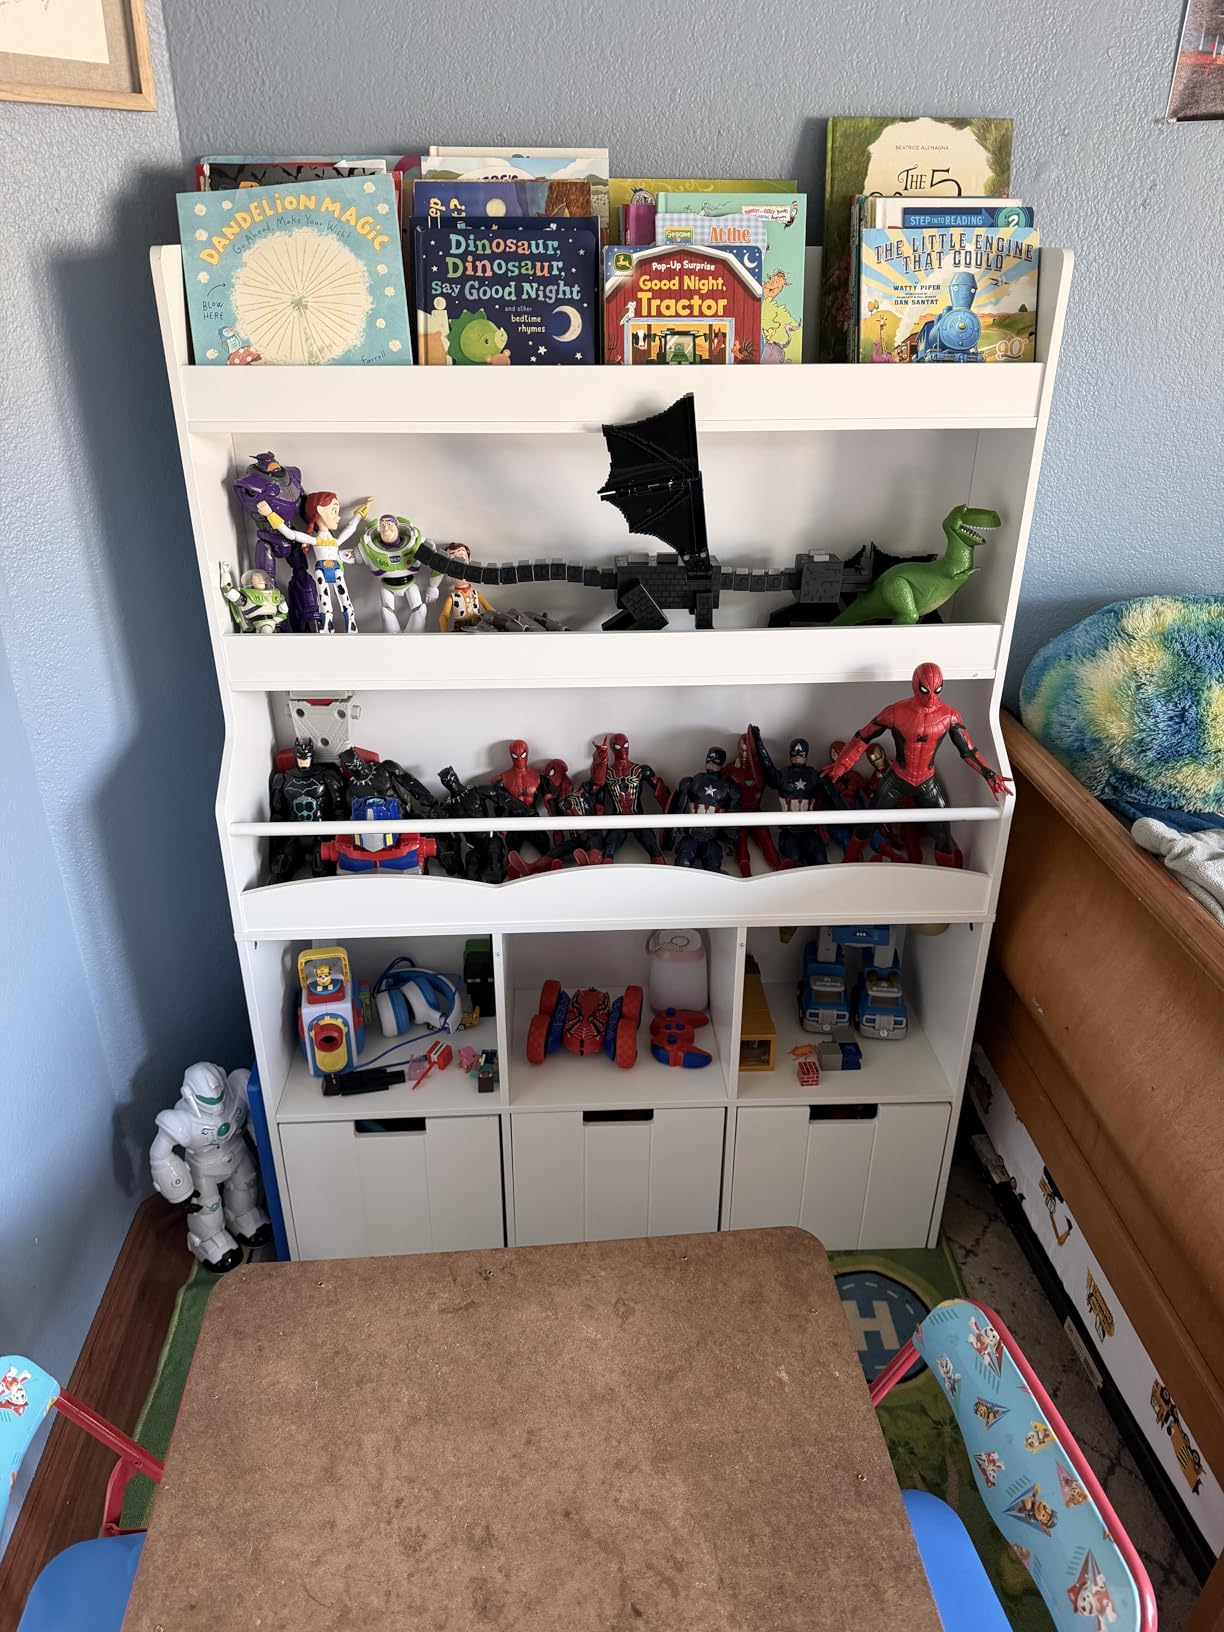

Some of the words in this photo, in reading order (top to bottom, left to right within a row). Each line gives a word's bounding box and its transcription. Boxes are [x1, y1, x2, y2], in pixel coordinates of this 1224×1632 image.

[910, 216, 930, 226] STEP
[946, 216, 983, 225] READING
[1008, 214, 1019, 228] 2
[232, 243, 246, 254] Go
[276, 216, 302, 229] Make
[304, 214, 323, 226] Your
[326, 221, 351, 242] Wish!
[709, 226, 724, 244] At
[726, 226, 751, 243] the
[449, 233, 561, 257] Dinosaur,
[874, 240, 904, 264] THE
[912, 232, 966, 254] LITTLE
[975, 234, 1034, 262] ENGINE
[446, 256, 566, 278] Dinosaur,
[652, 260, 682, 272] Pop-Up
[683, 260, 716, 272] Surprise
[902, 250, 944, 274] THAT
[953, 250, 1004, 272] COULD
[464, 280, 516, 300] Good
[522, 280, 582, 304] Night
[639, 275, 679, 291] Good
[683, 275, 726, 294] Night,
[637, 292, 728, 316] Tractor
[203, 312, 224, 320] HERE
[511, 314, 542, 323] bedtime
[518, 324, 546, 334] rhymes
[360, 350, 386, 366] Farrell
[842, 1300, 901, 1352] H
